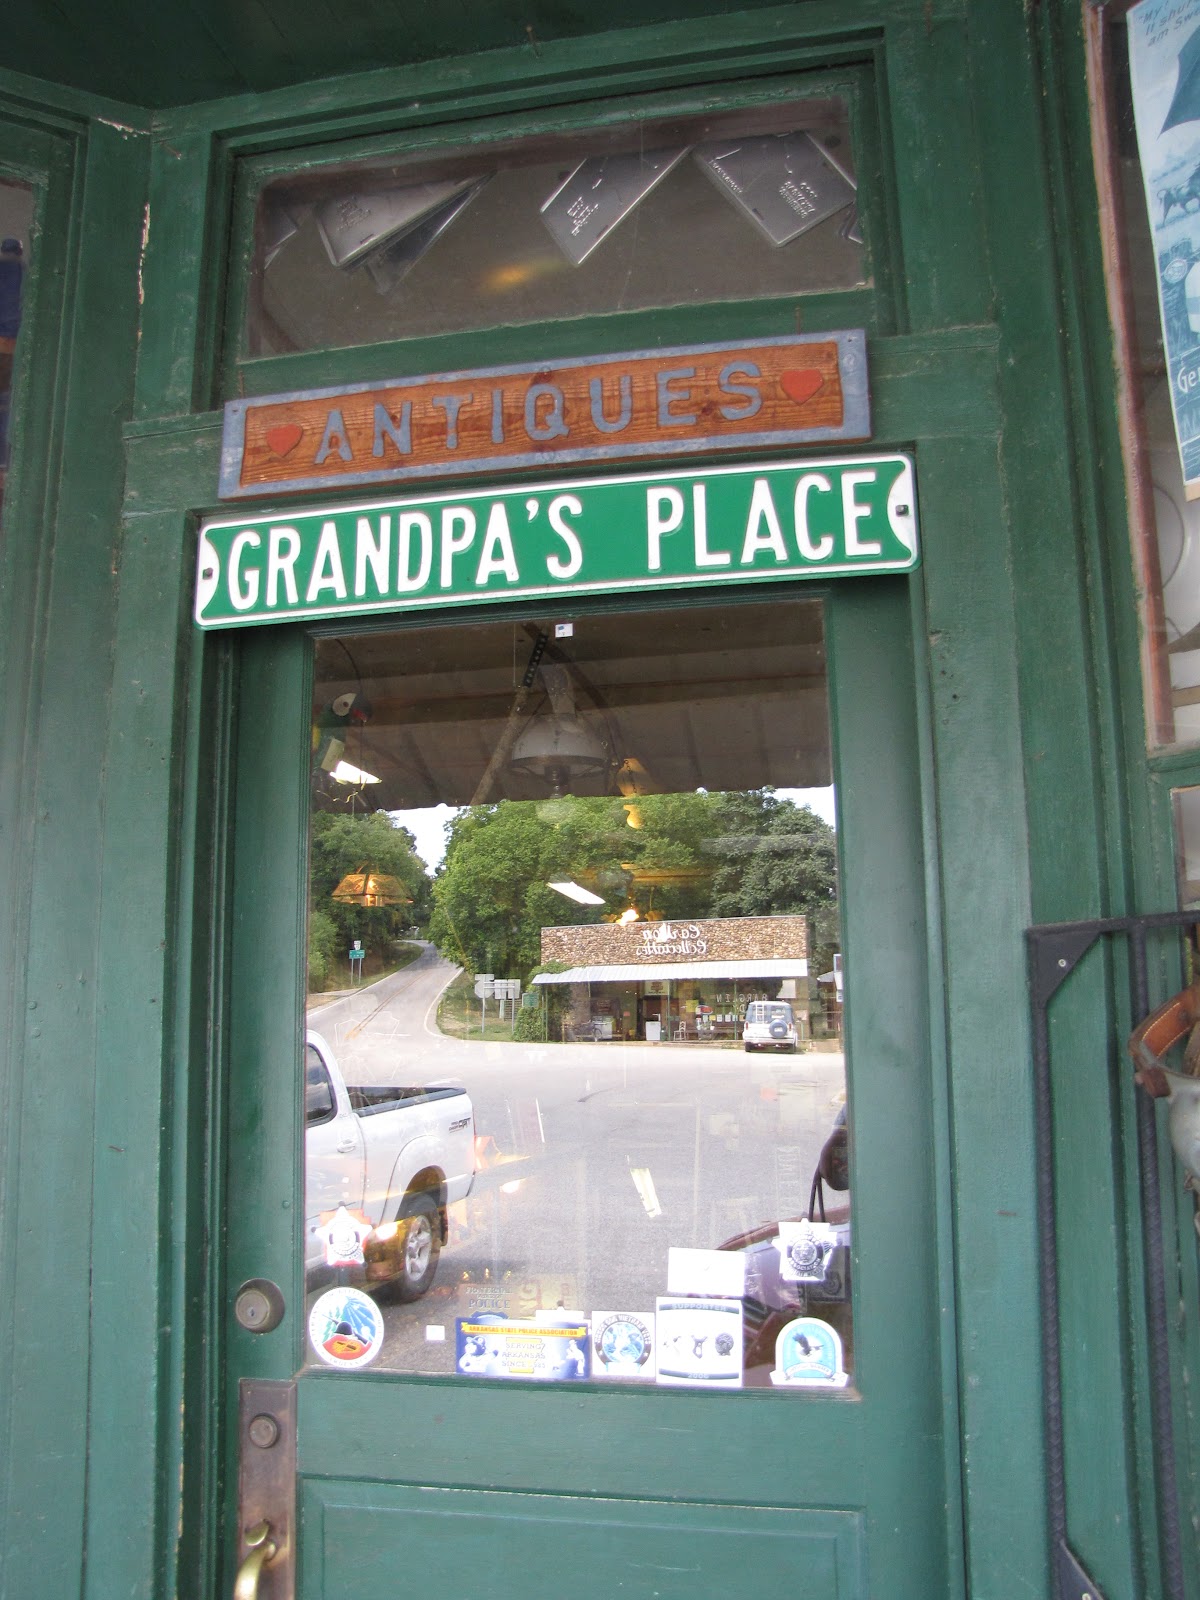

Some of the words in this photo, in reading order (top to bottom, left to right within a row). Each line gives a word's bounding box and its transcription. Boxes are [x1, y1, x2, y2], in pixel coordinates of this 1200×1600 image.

[1177, 366, 1200, 393] Ge
[315, 361, 763, 465] ANTIQUES
[227, 494, 583, 611] GRANDPA'S
[646, 471, 883, 571] PLACE
[469, 1299, 511, 1309] POLICE
[671, 1303, 727, 1312] SUPPORTER
[618, 1314, 645, 1330] VIETNAM
[469, 1325, 499, 1333] ARKANSAS
[540, 1328, 578, 1336] ASSOCIATION
